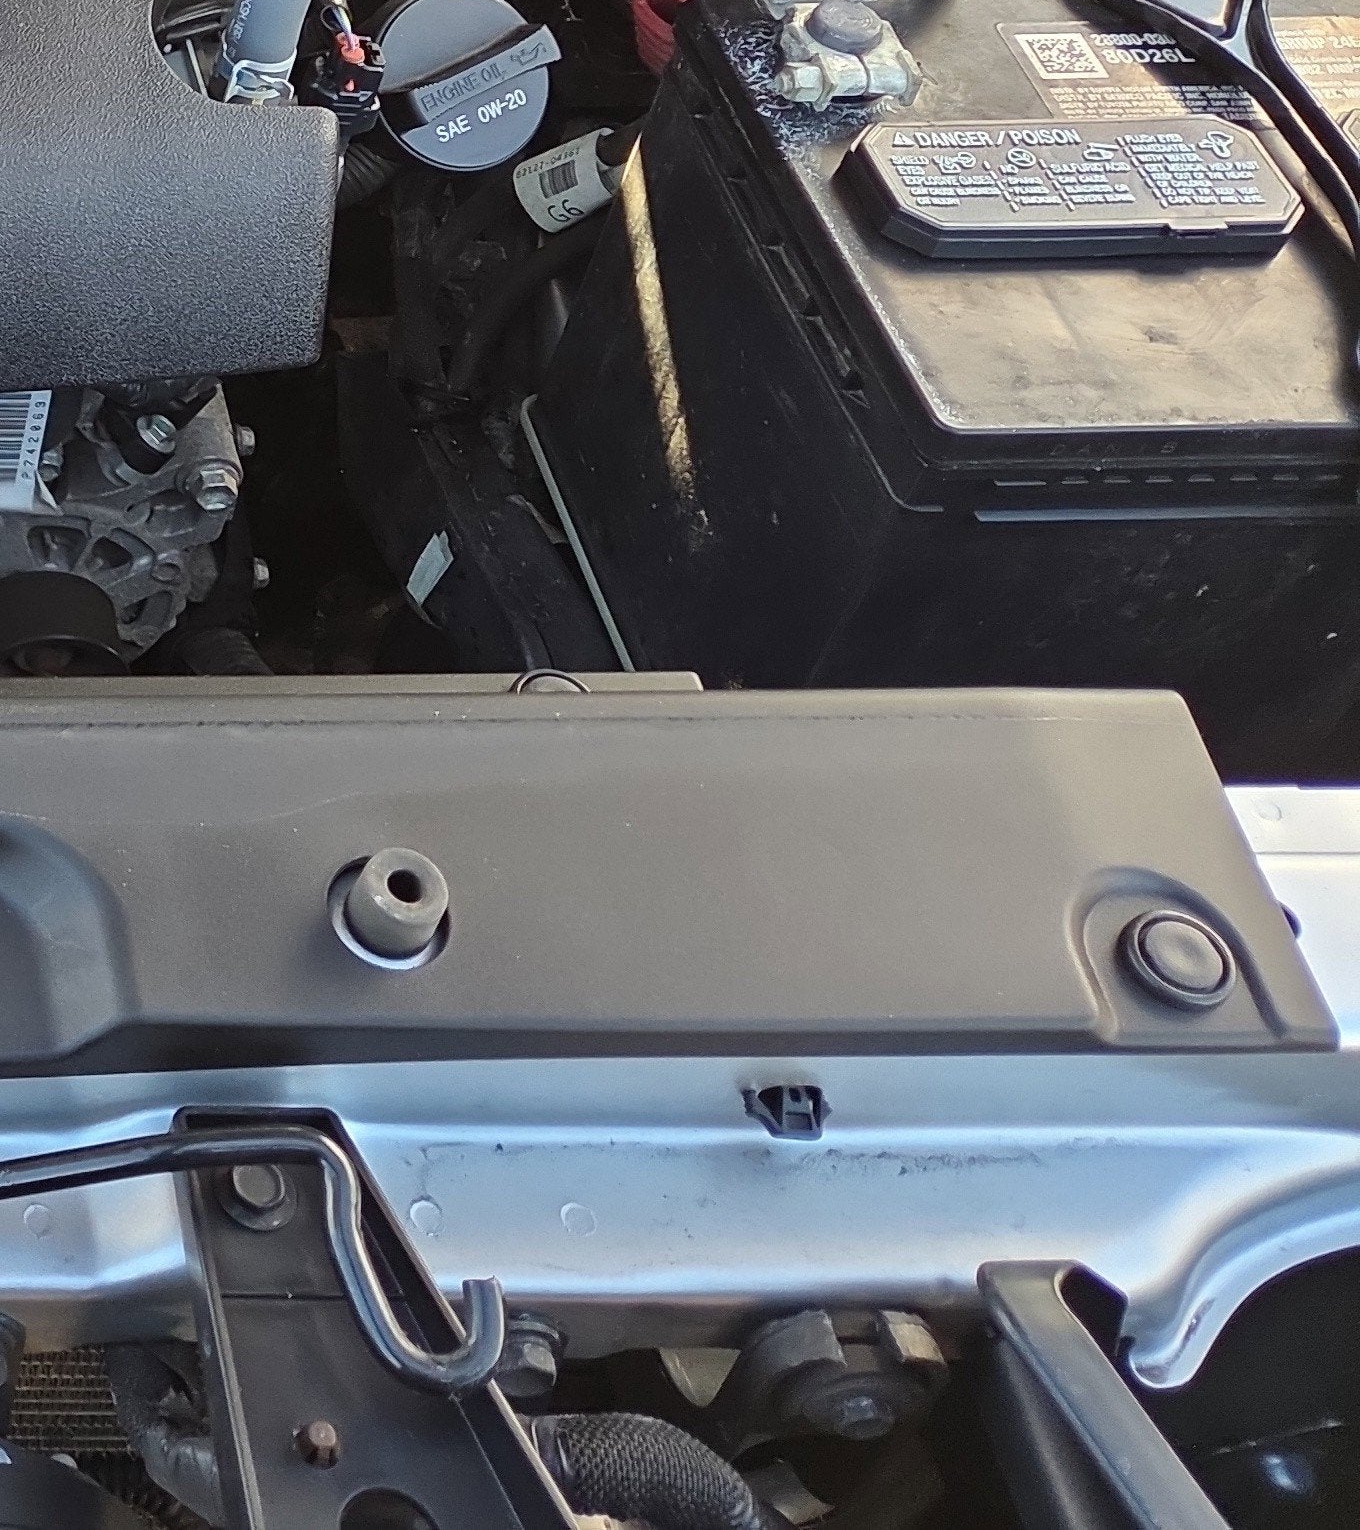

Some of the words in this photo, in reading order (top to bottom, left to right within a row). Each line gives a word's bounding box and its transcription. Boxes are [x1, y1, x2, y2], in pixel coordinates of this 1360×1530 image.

[1102, 48, 1196, 64] 80D26L
[421, 75, 480, 112] ENGINE
[481, 63, 502, 83] OIL
[435, 115, 472, 143] SAE
[477, 88, 527, 124] 0W-20
[912, 131, 993, 147] DANGER
[1008, 128, 1082, 145] POISON
[547, 199, 585, 222] G6
